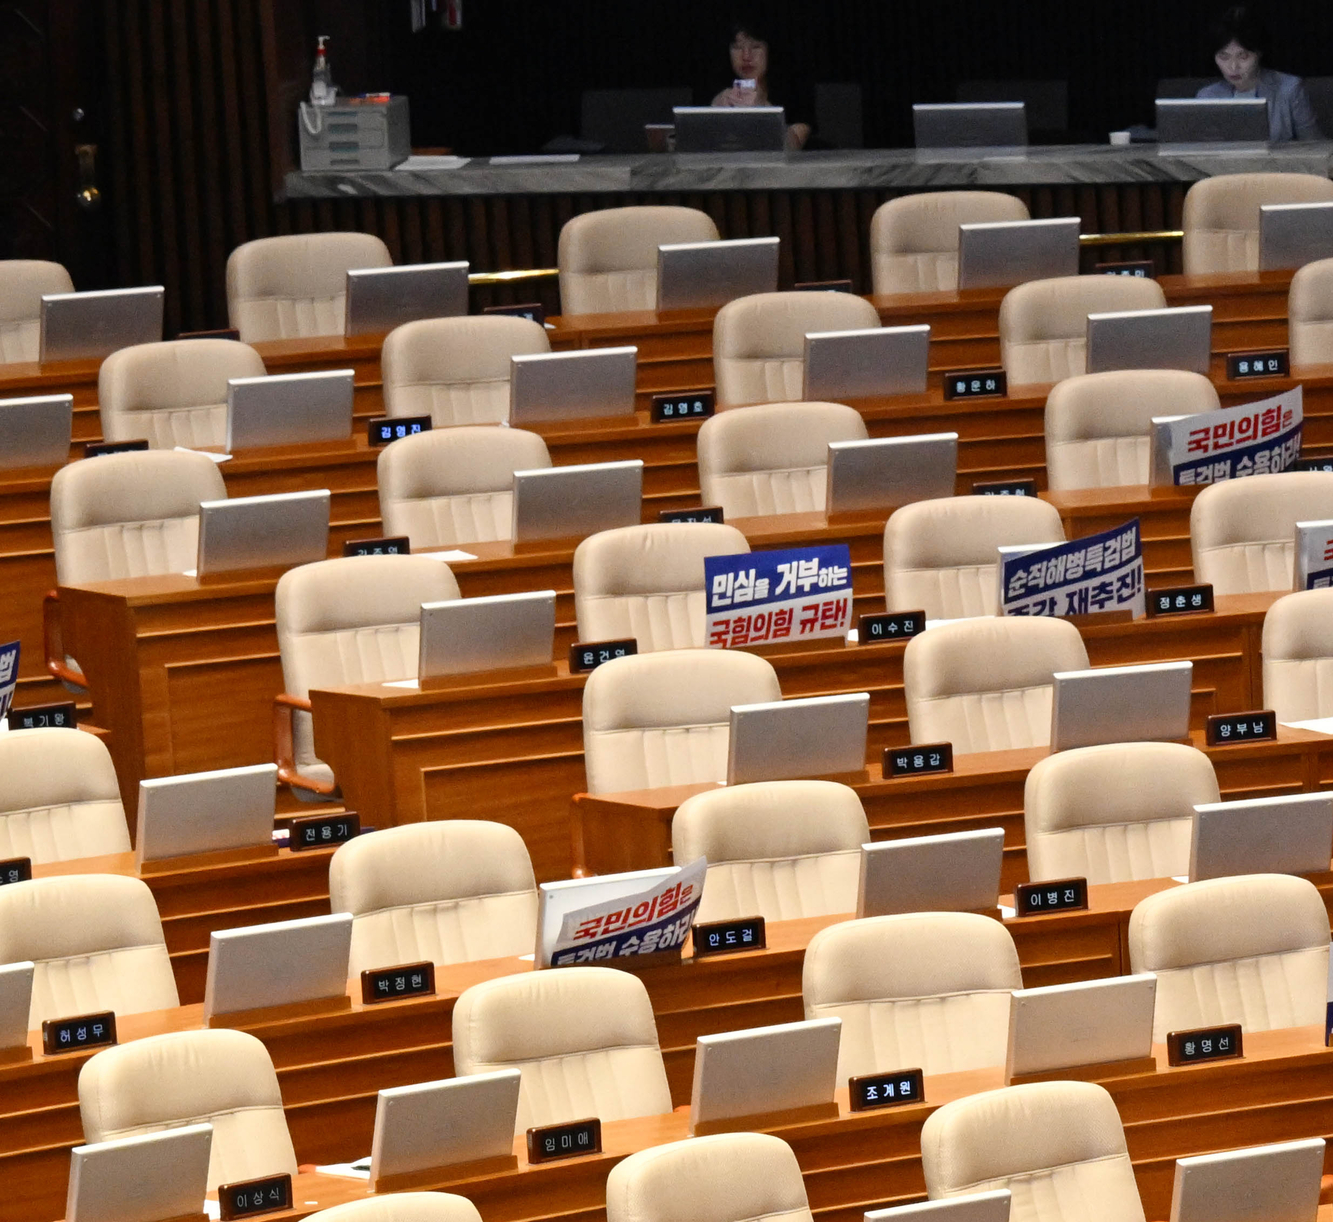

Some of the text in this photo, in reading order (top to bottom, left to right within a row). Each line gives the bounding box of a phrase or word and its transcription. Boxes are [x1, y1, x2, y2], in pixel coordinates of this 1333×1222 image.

[1239, 360, 1278, 373] 용혜인
[957, 378, 995, 393] 황운하
[664, 402, 703, 415] 김영호
[1188, 405, 1292, 453] 국민의힘은
[1008, 526, 1136, 598] 순직해병특검법
[712, 558, 848, 607] 민심을 거부하는
[1066, 564, 1141, 615] 재추진!
[1160, 594, 1202, 609] 정춘생
[710, 598, 848, 649] 국힘의힘 규탄!
[872, 620, 914, 635] 이수진
[1220, 721, 1264, 737] 양부남
[896, 753, 940, 769] 박용갑
[305, 824, 348, 841] 전용기
[1031, 889, 1075, 905] 이병진
[573, 881, 693, 940] 국민의힘은
[709, 929, 752, 946] 안도걸
[379, 974, 421, 992] 박정현
[60, 1024, 104, 1043] 허성무
[1185, 1037, 1229, 1055] 황명선
[867, 1081, 911, 1099] 조계원
[545, 1131, 589, 1151] 임미애
[237, 1188, 280, 1207] 이상식
